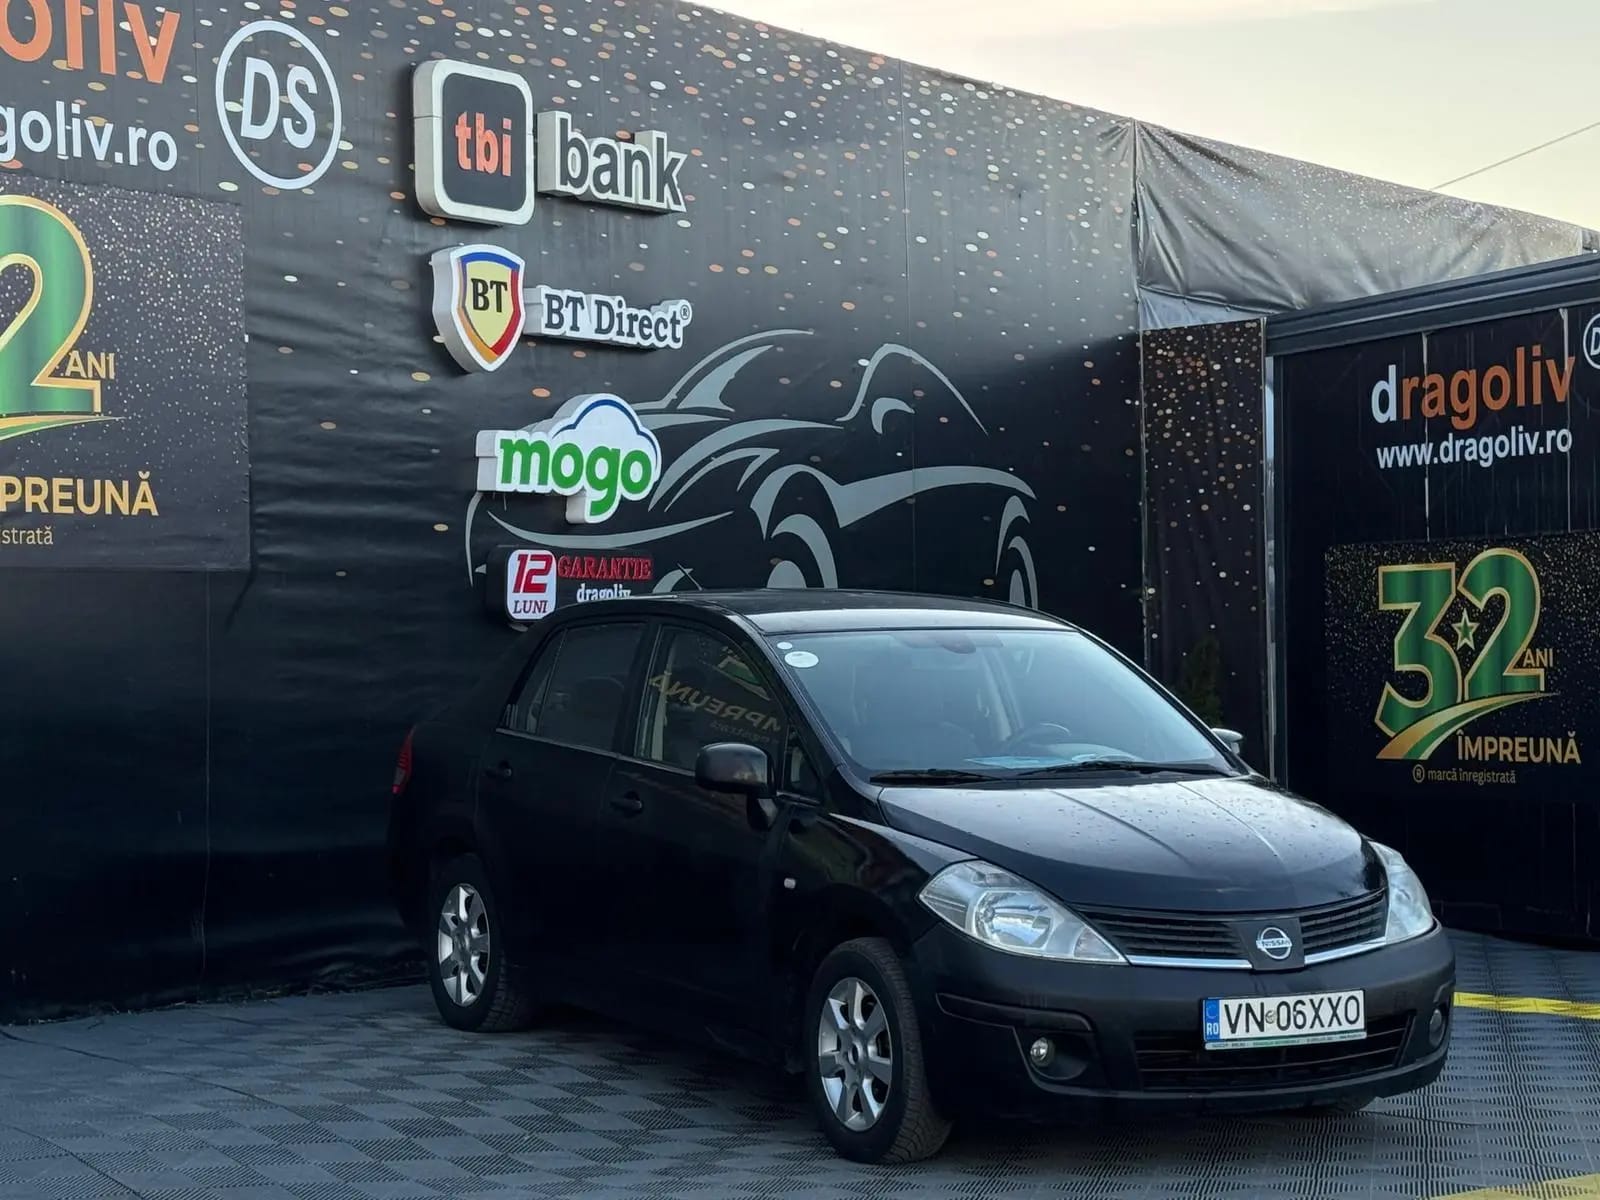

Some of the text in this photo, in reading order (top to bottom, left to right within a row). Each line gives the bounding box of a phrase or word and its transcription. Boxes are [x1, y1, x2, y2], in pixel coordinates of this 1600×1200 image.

[241, 57, 318, 149] DS
[455, 112, 685, 206] tbi bank
[470, 278, 508, 313] BT
[545, 293, 585, 332] BT
[65, 351, 116, 379] ANI
[1371, 344, 1576, 430] dragoliv
[1376, 425, 1573, 469] www.dragoliv.ro
[500, 438, 652, 516] mogo
[512, 553, 552, 593] 12
[557, 555, 653, 581] GARANTIE
[513, 600, 548, 614] LUNI
[1375, 547, 1545, 738] 32
[1522, 648, 1554, 667] ANI
[1456, 729, 1581, 764] ÎMPREUNĂ
[1427, 767, 1458, 782] marcă
[1459, 767, 1517, 786] înregistrată
[1206, 1022, 1220, 1035] RO
[1224, 1001, 1265, 1034] VN
